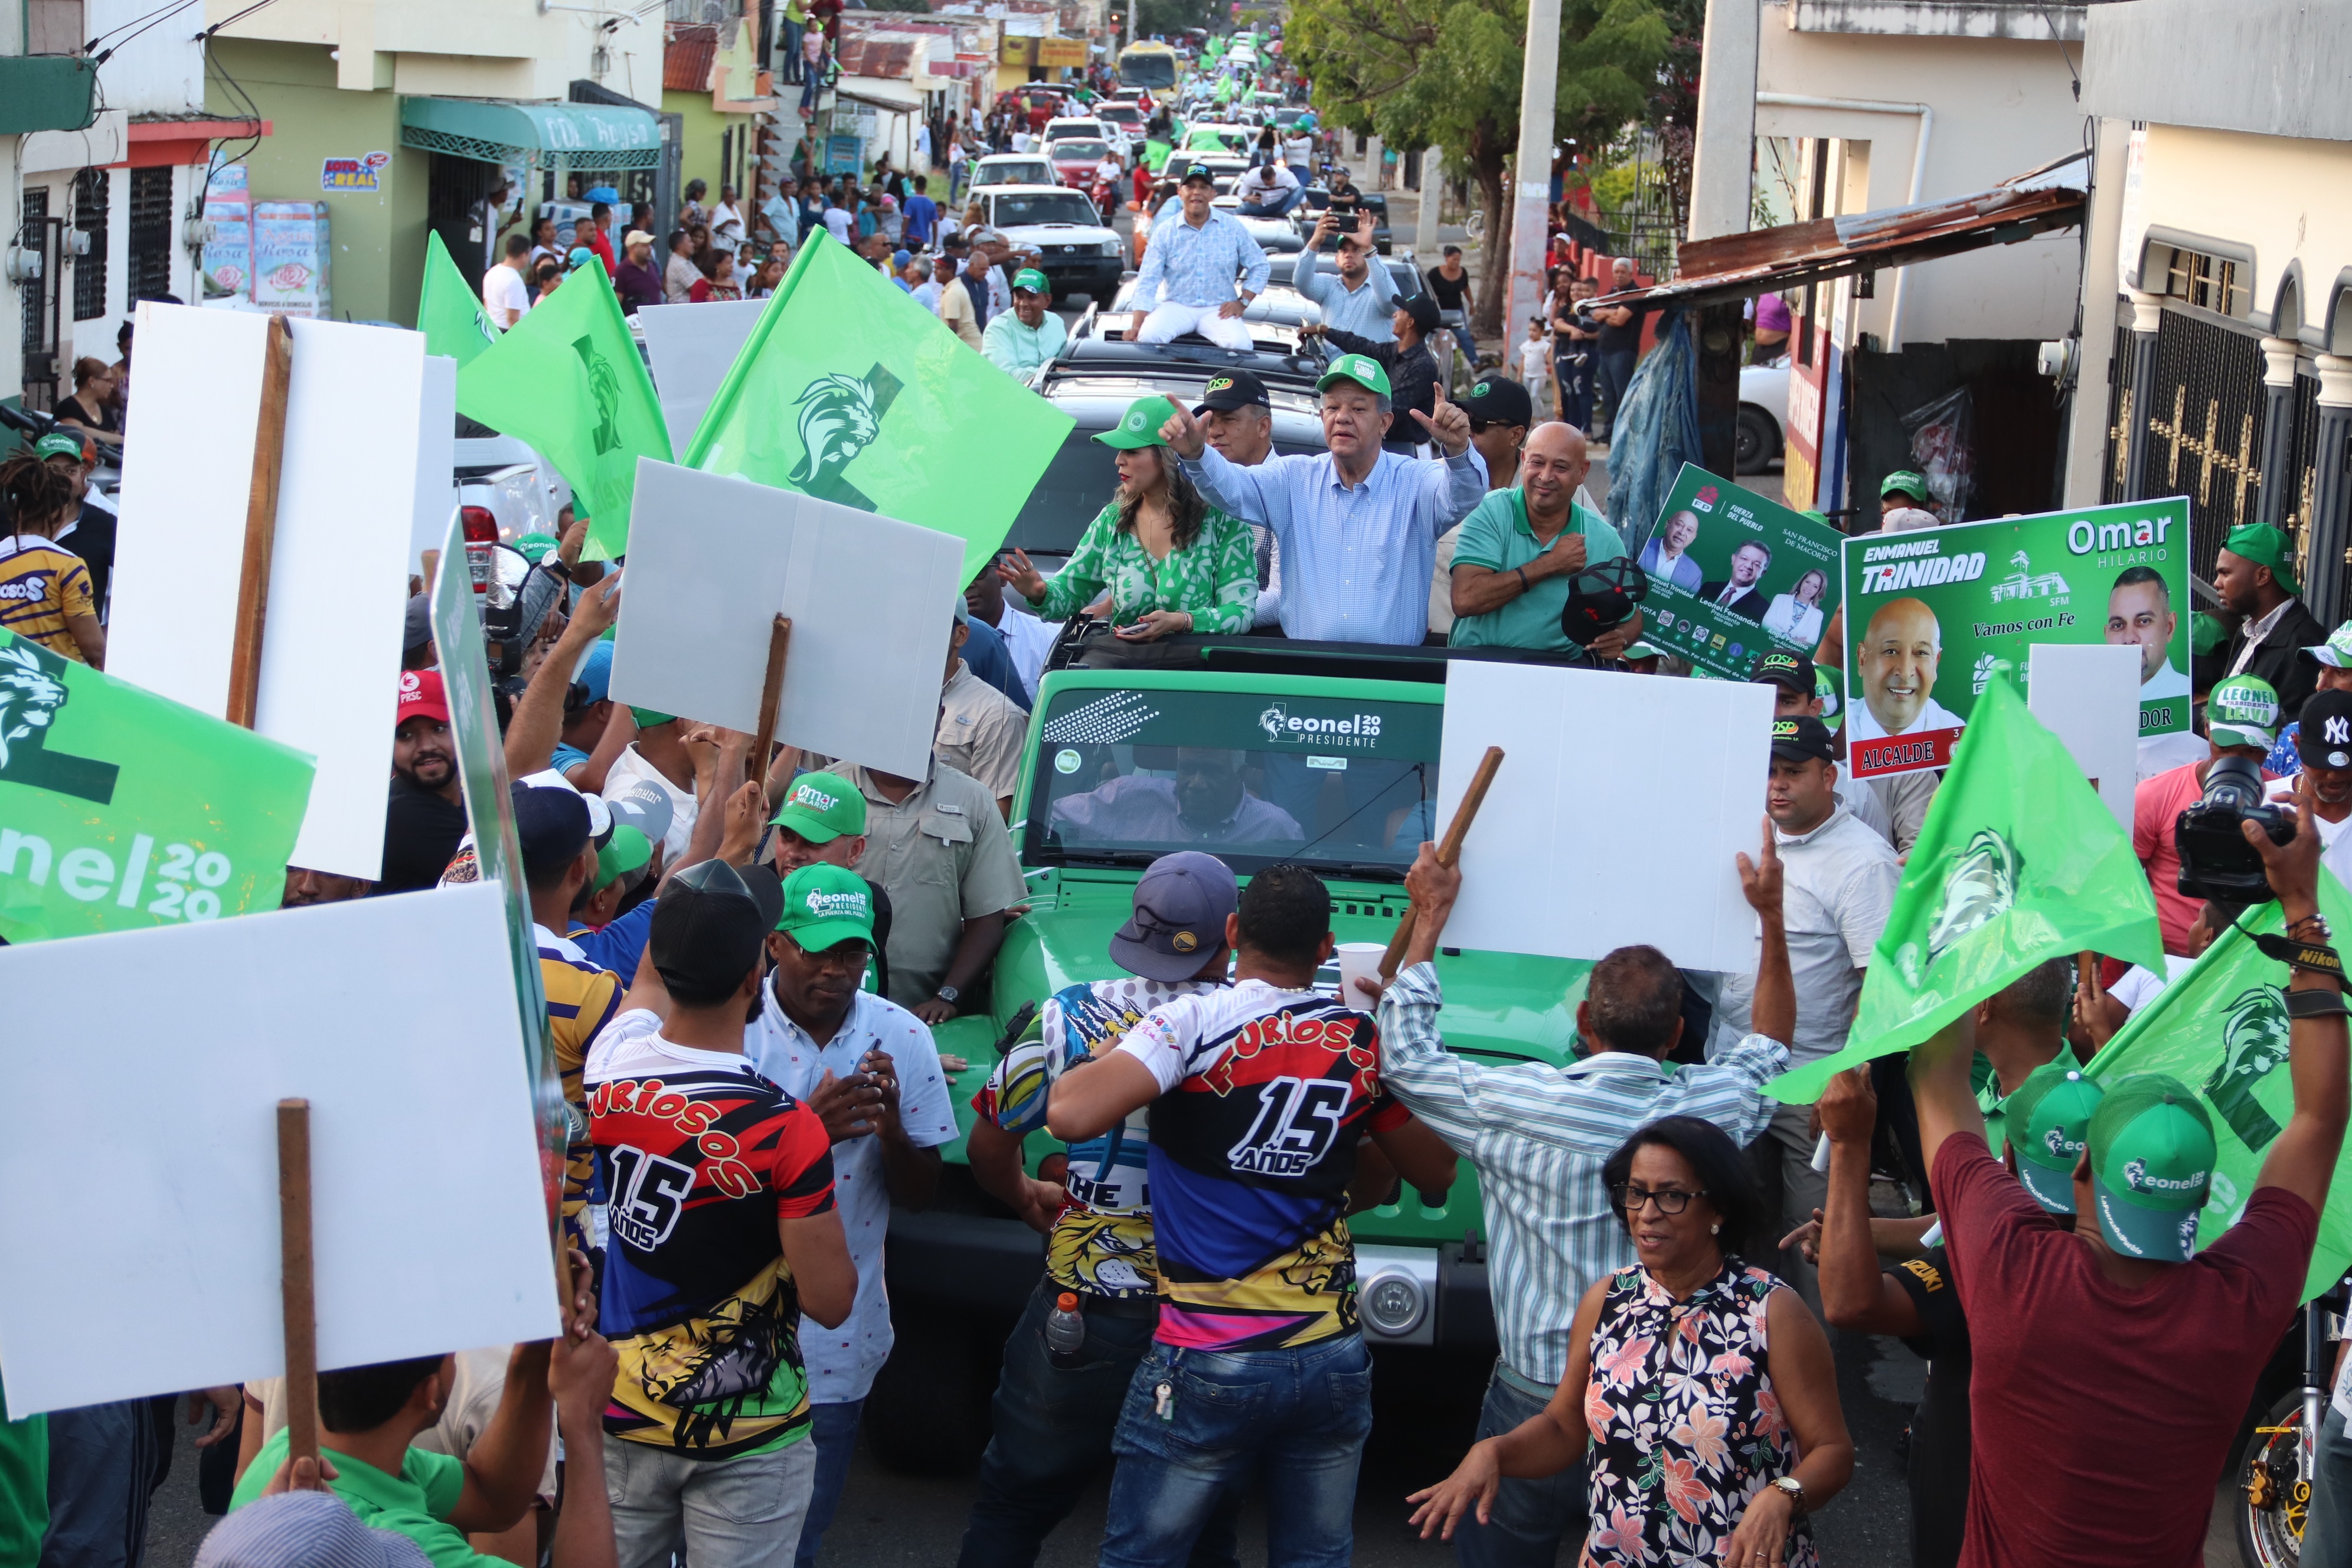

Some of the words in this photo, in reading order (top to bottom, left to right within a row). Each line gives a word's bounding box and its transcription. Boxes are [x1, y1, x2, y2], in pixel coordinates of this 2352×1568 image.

[326, 161, 358, 171] LOTO
[335, 173, 375, 186] REAL
[258, 243, 309, 257] Rosa
[1354, 364, 1375, 377] TRINIDAD
[1355, 360, 1374, 370] ENMANUEL
[1694, 501, 1710, 511] FP
[1730, 504, 1754, 520] FUERZA
[1727, 511, 1738, 521] DEL
[1739, 517, 1763, 531] PUEBLO
[1782, 528, 1798, 539] SAN
[1798, 535, 1837, 557] FRANCISCO
[2067, 516, 2173, 556] Omar
[1785, 538, 1796, 547] DE
[1796, 543, 1829, 561] MACORIS
[1863, 538, 1939, 561] ENMANUEL
[2098, 548, 2167, 569] HILARIO
[1860, 552, 1987, 594] TRINIDAD
[1651, 588, 1670, 599] 2020-2024
[1652, 583, 1673, 596] Alcalde
[1670, 584, 1694, 599] Trinidad
[2049, 596, 2070, 607] SFM
[1639, 605, 1656, 616] VOTA
[1699, 597, 1723, 612] Leonel
[1723, 607, 1760, 628] Fernandez
[1710, 609, 1740, 626] Presidente
[1713, 616, 1733, 628] 2020-2024
[1972, 619, 2023, 639] Vamos
[2027, 616, 2053, 632] con
[2057, 612, 2076, 628] Fe
[1767, 629, 1785, 640] Angie
[1786, 636, 1808, 650] Paulino
[1706, 657, 1732, 674] bienestar
[1765, 654, 1794, 665] COSP
[400, 691, 422, 704] PRSC
[2223, 688, 2275, 704] LEONEL
[2226, 701, 2269, 709] PRESIDENTE
[2226, 707, 2269, 723] LEIVA
[1772, 721, 1796, 733] OSP
[1954, 729, 1959, 738] 3
[2325, 715, 2350, 744] NY
[1299, 734, 1376, 748] PRESIDENTE
[1862, 741, 1934, 770] ALCALDE
[797, 797, 828, 811] HILARIO
[798, 785, 839, 808] Omar
[2298, 949, 2340, 968] Nikon
[1203, 1011, 1380, 1103] FURIOSOS
[1231, 1077, 1351, 1169] 15
[589, 1079, 762, 1199] URIOSOS
[1231, 1144, 1313, 1176] AÑOS
[609, 1144, 697, 1240] 15
[2022, 1169, 2069, 1213] LaFuerzaDelPueblo
[2101, 1195, 2143, 1255] LaFuerzaDelPueblo
[1900, 1259, 1943, 1293] UZUKI
